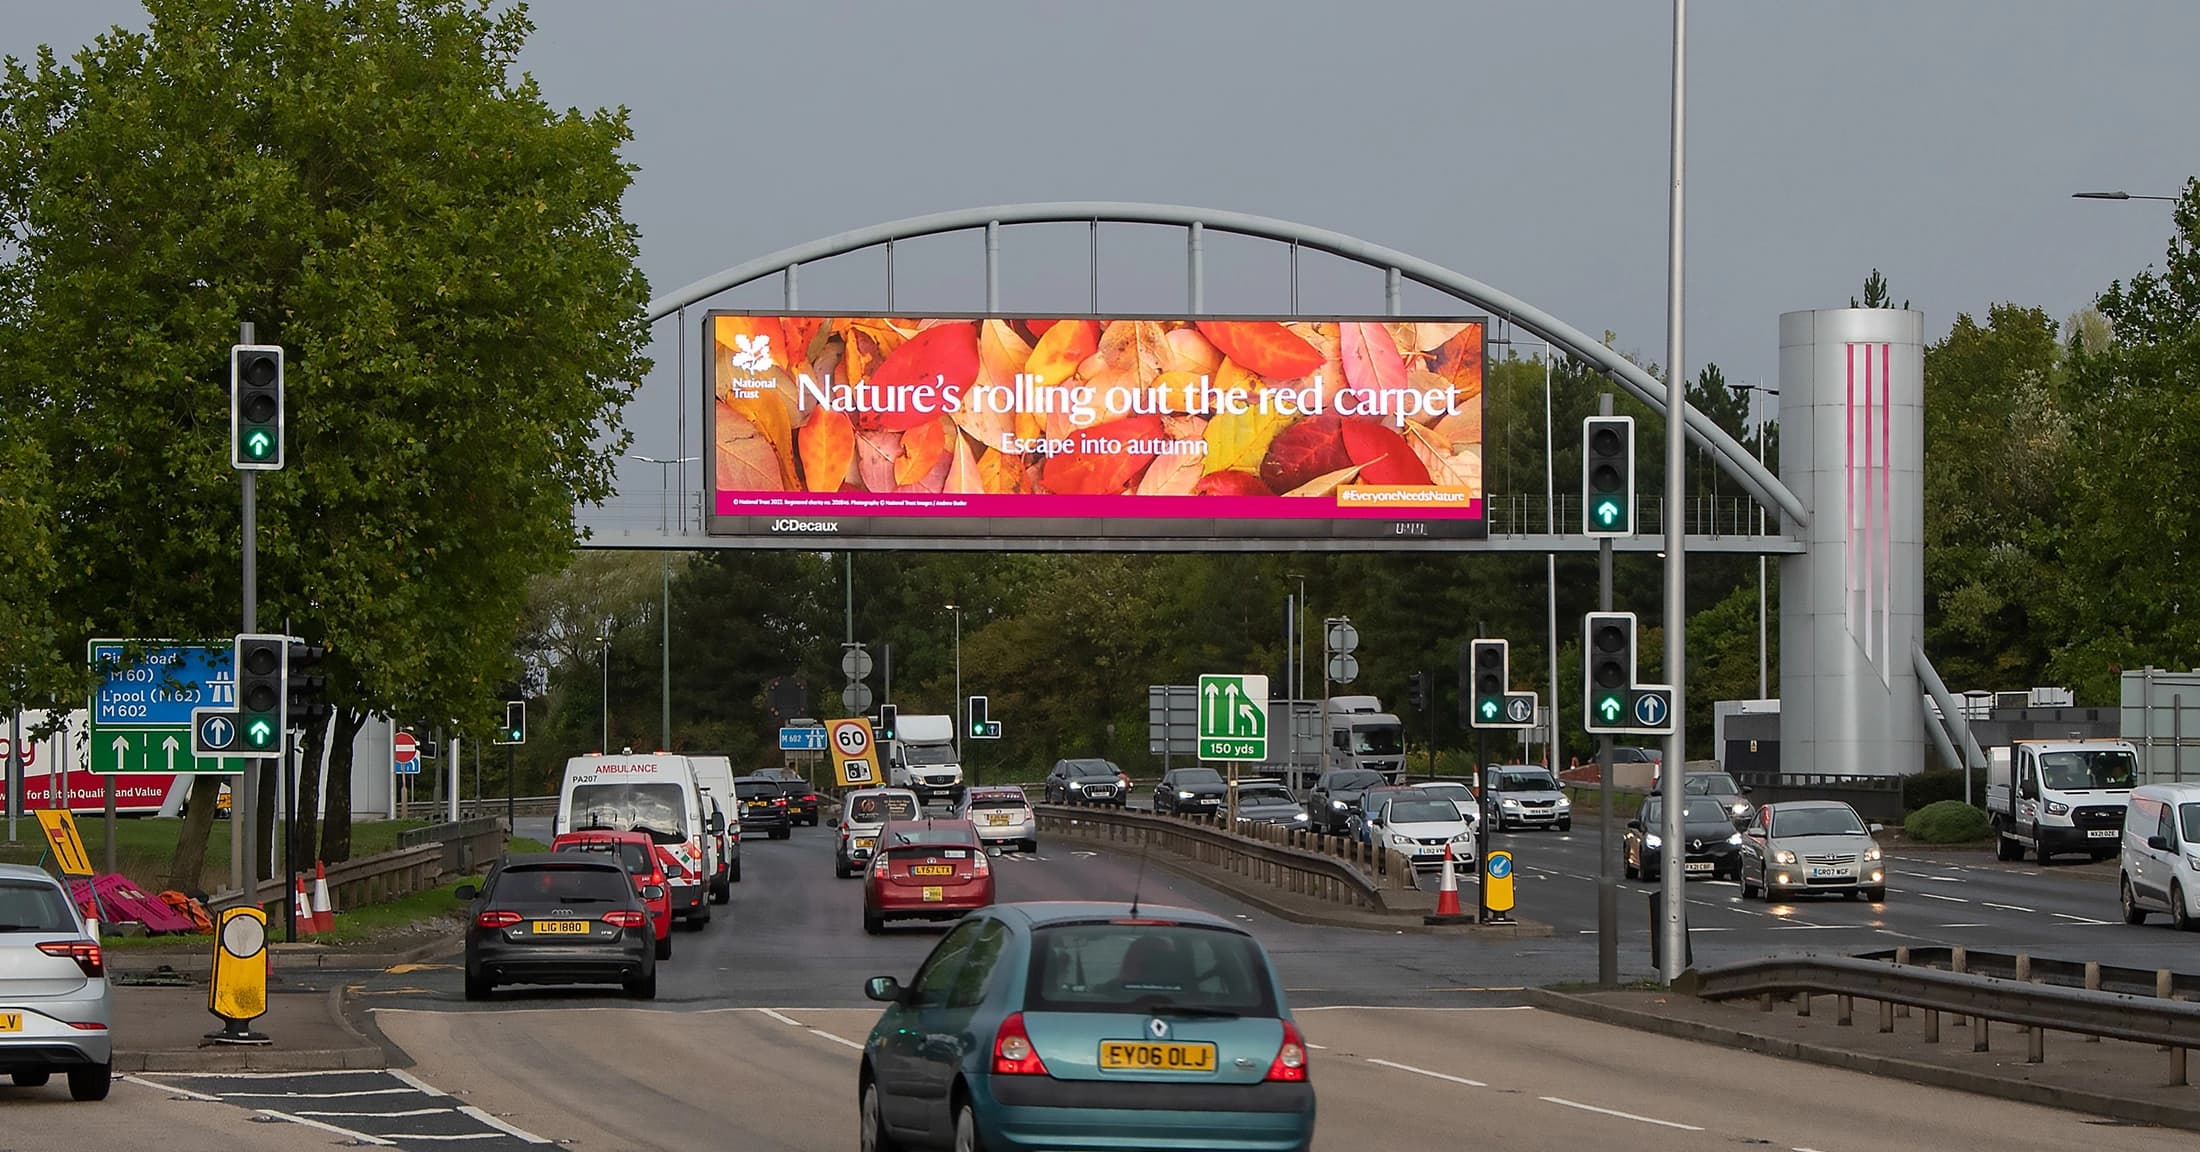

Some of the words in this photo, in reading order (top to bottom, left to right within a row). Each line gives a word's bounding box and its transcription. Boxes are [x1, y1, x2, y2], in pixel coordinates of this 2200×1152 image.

[733, 377, 776, 390] National
[733, 388, 760, 400] Trust
[972, 374, 1097, 426] rolling
[1105, 383, 1173, 415] out
[1183, 375, 1249, 415] the
[1259, 376, 1323, 415] red
[1334, 383, 1462, 427] carpet
[1001, 433, 1074, 458] Escape
[1082, 433, 1121, 455] into
[1127, 437, 1208, 455] autumn
[1342, 490, 1465, 504] #EveryoneNeedsNature
[771, 518, 838, 532] JCDecaux
[175, 688, 201, 704] 62)
[102, 705, 115, 717] M
[118, 705, 147, 717] 602
[838, 730, 866, 748] 60
[1210, 743, 1232, 755] 150
[1234, 743, 1255, 757] yds
[595, 764, 658, 774] AMBULANCE
[572, 775, 598, 784] PA207
[26, 789, 42, 800] for
[115, 787, 133, 798] and
[134, 786, 162, 798] Value
[541, 923, 557, 932] LIG
[1109, 1046, 1162, 1066] EY06
[1168, 1047, 1207, 1067] OLJ
